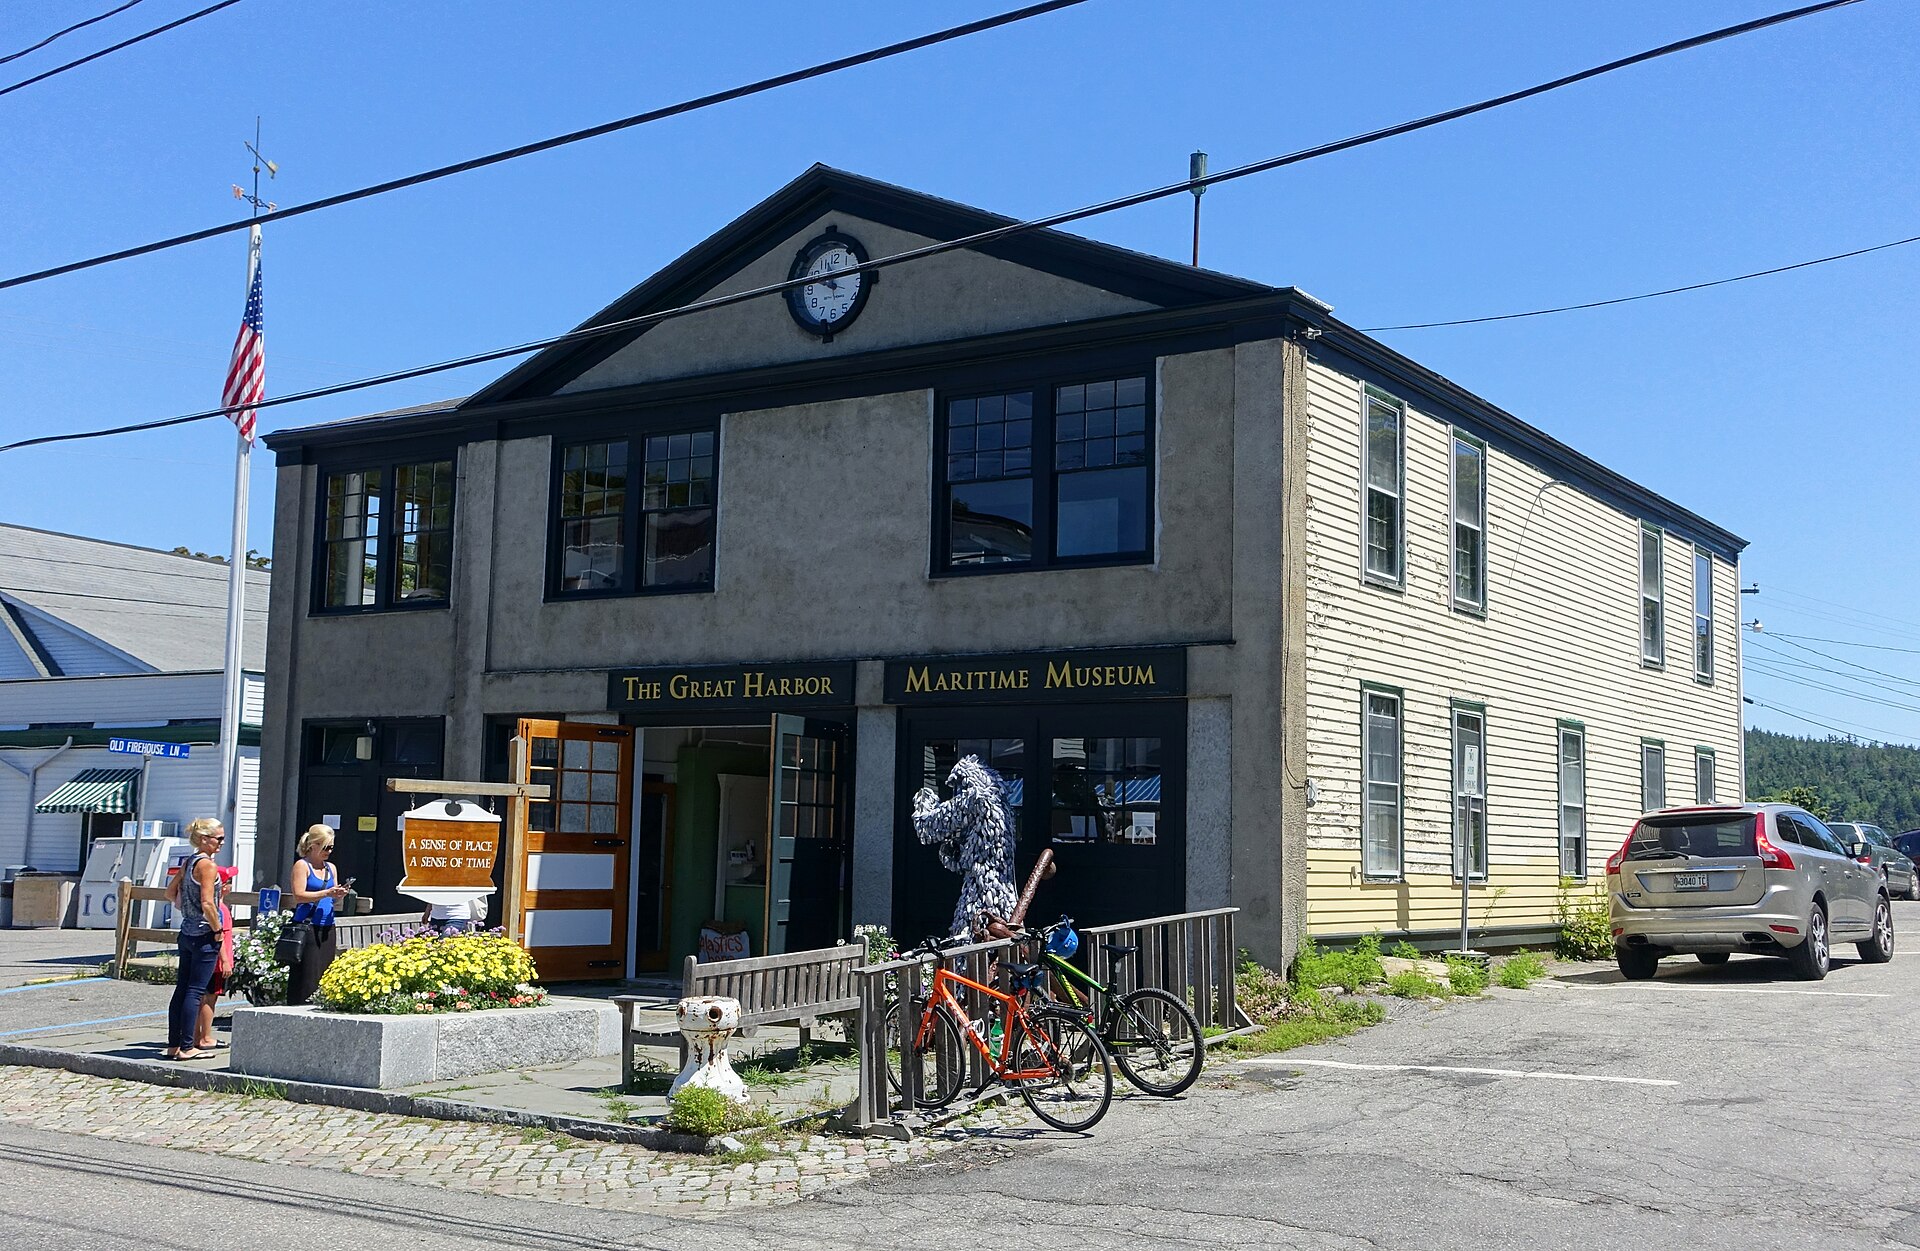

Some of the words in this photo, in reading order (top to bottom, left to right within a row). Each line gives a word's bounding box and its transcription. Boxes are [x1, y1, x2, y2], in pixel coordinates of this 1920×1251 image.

[820, 259, 827, 270] 11
[830, 254, 840, 264] 12
[806, 285, 813, 295] 9
[811, 297, 818, 308] 8
[841, 303, 848, 313] 5
[819, 306, 825, 316] 7
[829, 308, 837, 319] 6
[904, 665, 1029, 693] MARITIME
[1043, 660, 1156, 689] MUSEUM
[622, 676, 661, 701] THE
[669, 674, 736, 699] GREAT
[742, 672, 834, 698] HARBOR
[109, 739, 124, 751] OLD
[126, 741, 165, 755] FIREHOUSE
[169, 745, 180, 757] LN
[408, 838, 417, 849] A
[420, 838, 446, 850] SENSE
[449, 839, 463, 851] OF
[465, 840, 493, 852] PLACE
[409, 856, 417, 867] A
[421, 856, 447, 868] SENSE
[450, 857, 464, 868] OF
[466, 857, 491, 869] TIME
[82, 893, 116, 916] IC
